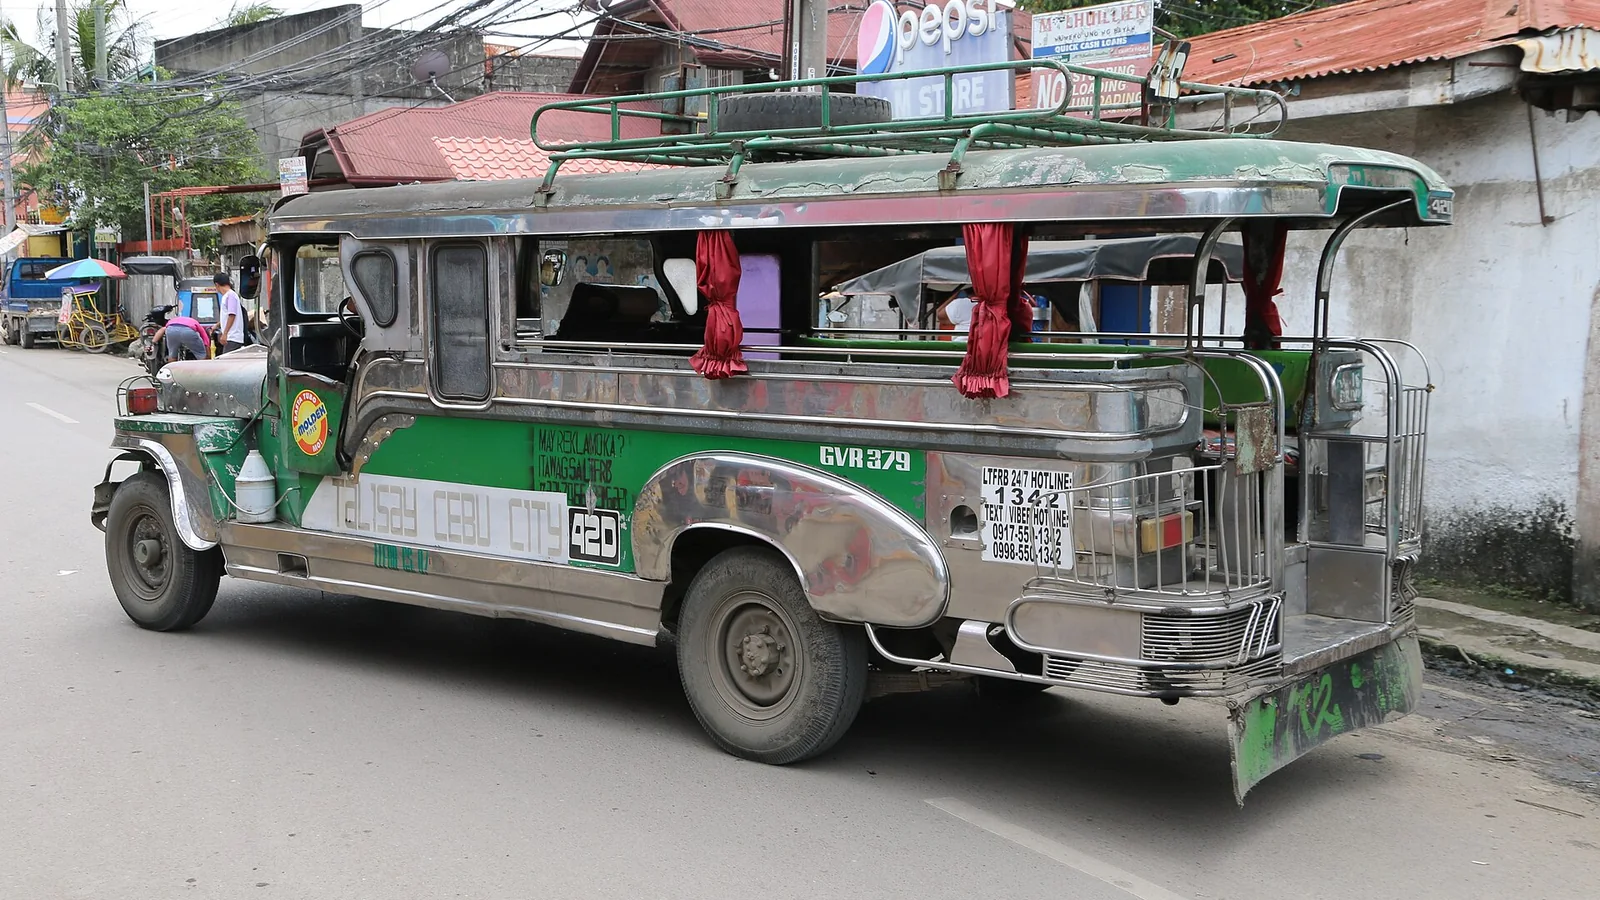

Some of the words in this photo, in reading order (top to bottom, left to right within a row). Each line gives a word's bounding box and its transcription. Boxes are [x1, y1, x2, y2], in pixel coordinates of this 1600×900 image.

[897, 0, 996, 65] pepsi
[1054, 43, 1079, 53] QUICK
[1080, 40, 1100, 49] CASH
[1101, 36, 1128, 48] LOANS
[1037, 72, 1069, 109] NO
[539, 429, 555, 452] MAY
[819, 445, 863, 469] GVR
[866, 449, 910, 472] 379
[983, 467, 1009, 486] LTFRB
[1031, 471, 1072, 491] HOTLINE:
[433, 489, 491, 547] CEBU
[984, 503, 1003, 522] TEXT
[1033, 507, 1069, 528] HOTINE:
